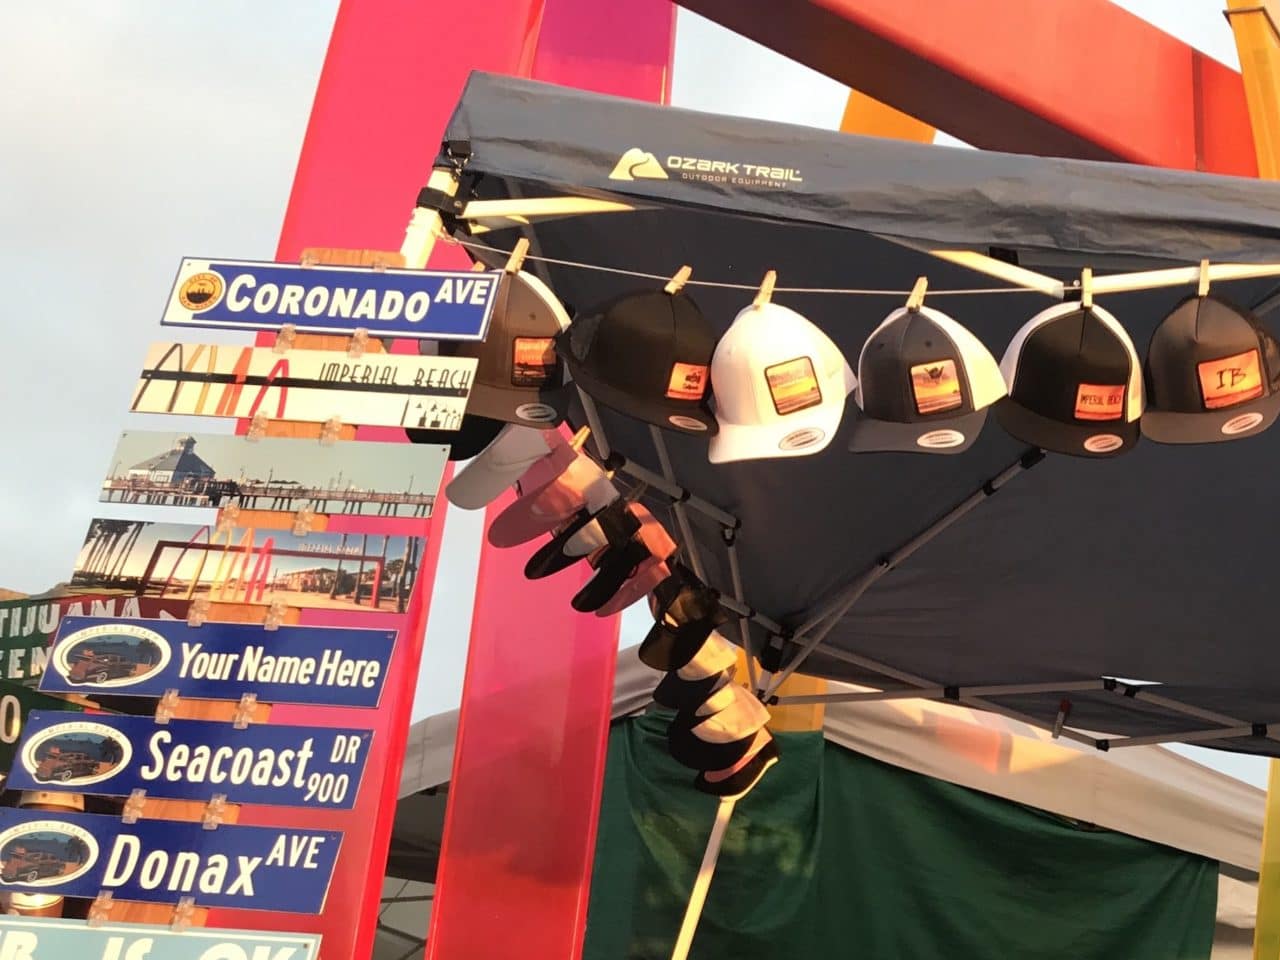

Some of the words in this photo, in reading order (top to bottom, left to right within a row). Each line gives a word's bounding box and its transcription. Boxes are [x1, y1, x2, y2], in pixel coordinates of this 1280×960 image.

[667, 154, 739, 174] OZARK
[742, 164, 803, 182] TRAIL
[682, 172, 727, 183] OUTDOOR
[731, 177, 787, 188] EQUIPMENT
[226, 273, 431, 322] CORONADO
[433, 280, 490, 305] AVE
[319, 362, 398, 385] IMPERIAL
[413, 368, 472, 389] BEACH
[1216, 368, 1248, 390] IB
[178, 643, 239, 681] Your
[237, 645, 313, 685] Name
[319, 649, 380, 688] Here
[141, 730, 314, 789] Seacoast
[330, 735, 361, 765] DR
[303, 772, 349, 804] 900
[102, 834, 263, 897] Donax
[266, 834, 325, 870] AVE
